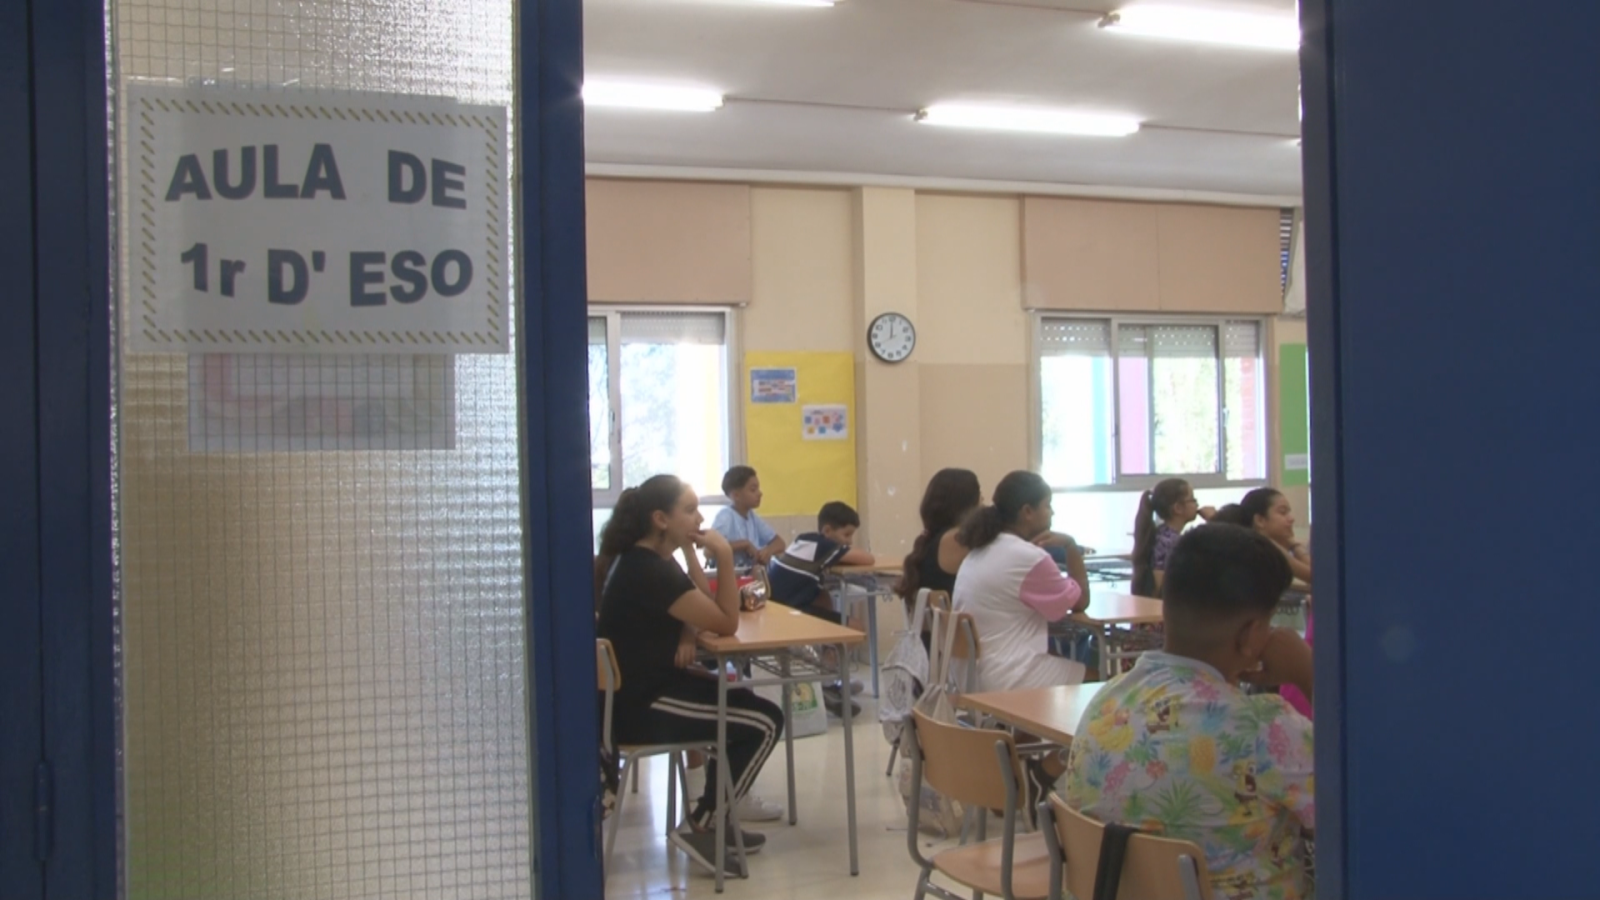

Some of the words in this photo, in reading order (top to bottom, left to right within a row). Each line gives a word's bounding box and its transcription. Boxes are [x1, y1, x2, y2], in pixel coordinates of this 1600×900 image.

[165, 142, 347, 202] AULA
[387, 149, 467, 210] DE
[180, 242, 246, 298] 1r
[267, 248, 326, 306] D'
[349, 248, 473, 307] ESO
